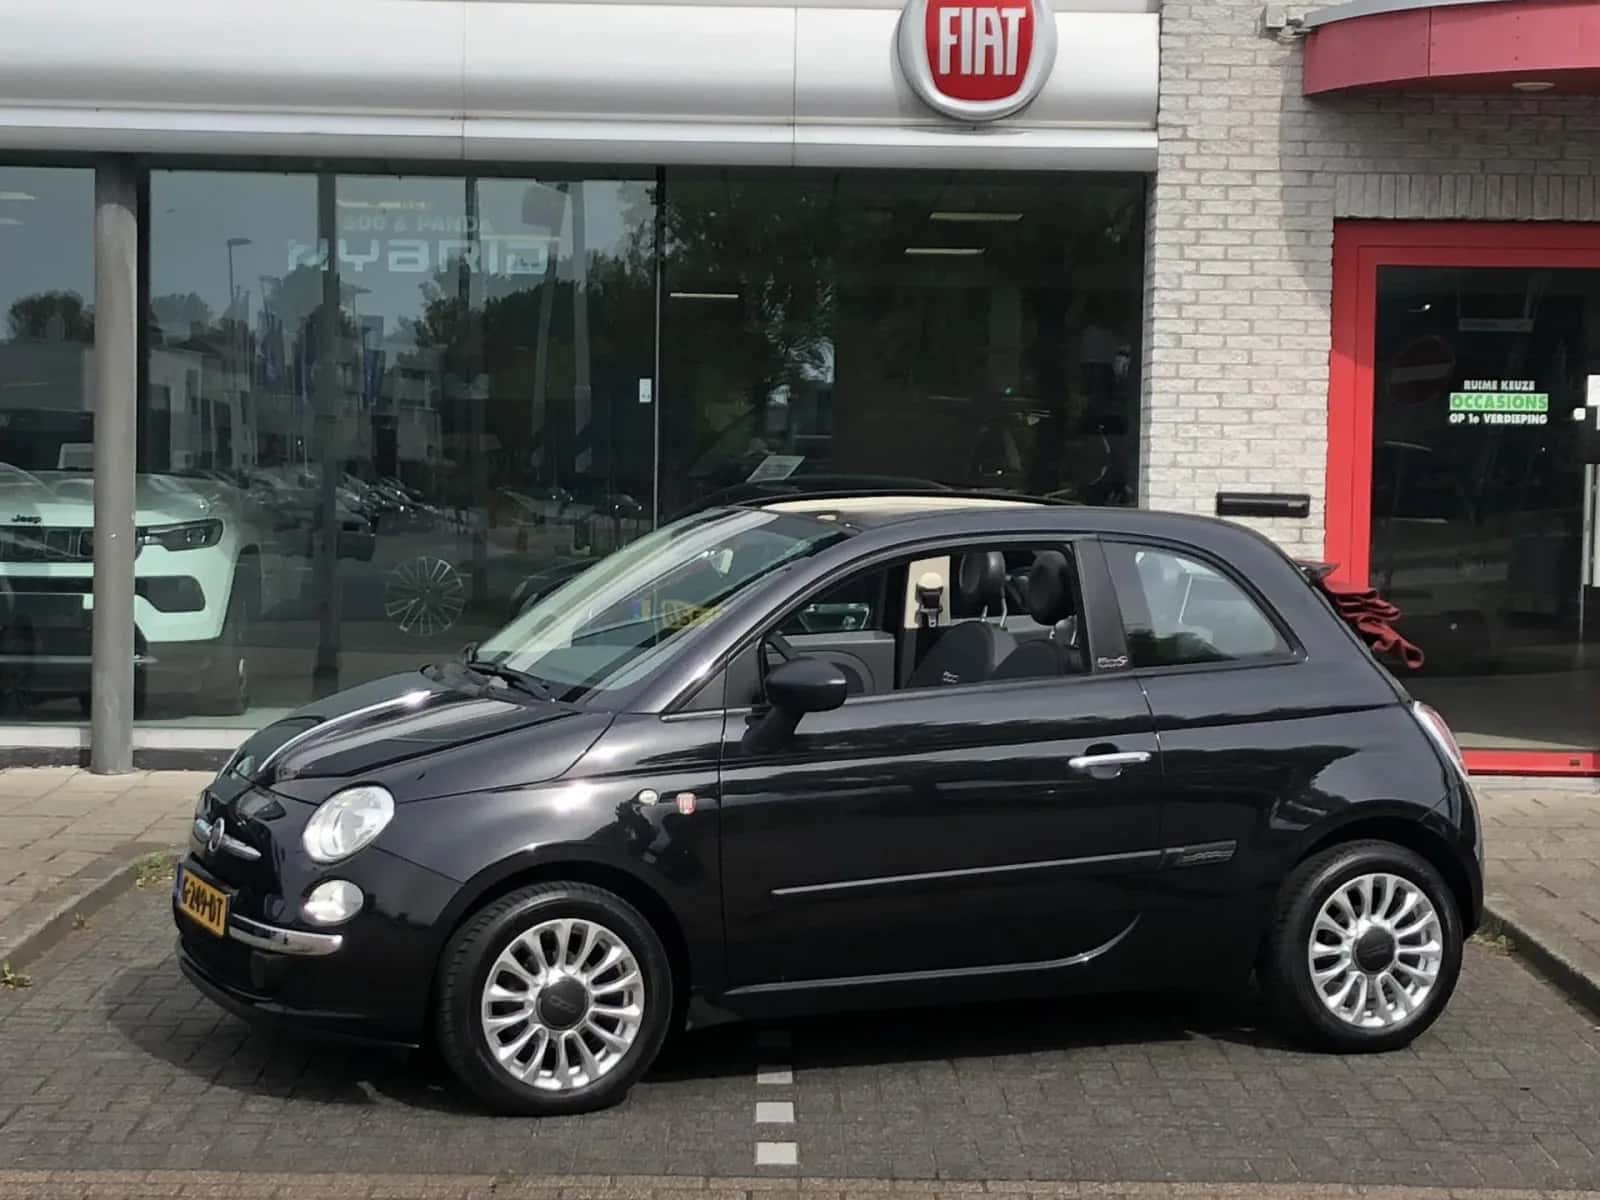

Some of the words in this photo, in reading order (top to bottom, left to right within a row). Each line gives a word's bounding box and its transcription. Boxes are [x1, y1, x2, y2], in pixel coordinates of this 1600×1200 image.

[939, 6, 1026, 75] FIAT
[287, 239, 549, 274] HYBRID
[1463, 380, 1498, 390] RUIME
[1501, 380, 1535, 391] KEUZE
[1452, 394, 1547, 410] OCCASIONS
[1449, 413, 1465, 423] OP
[1483, 413, 1548, 424] VERDIEPING
